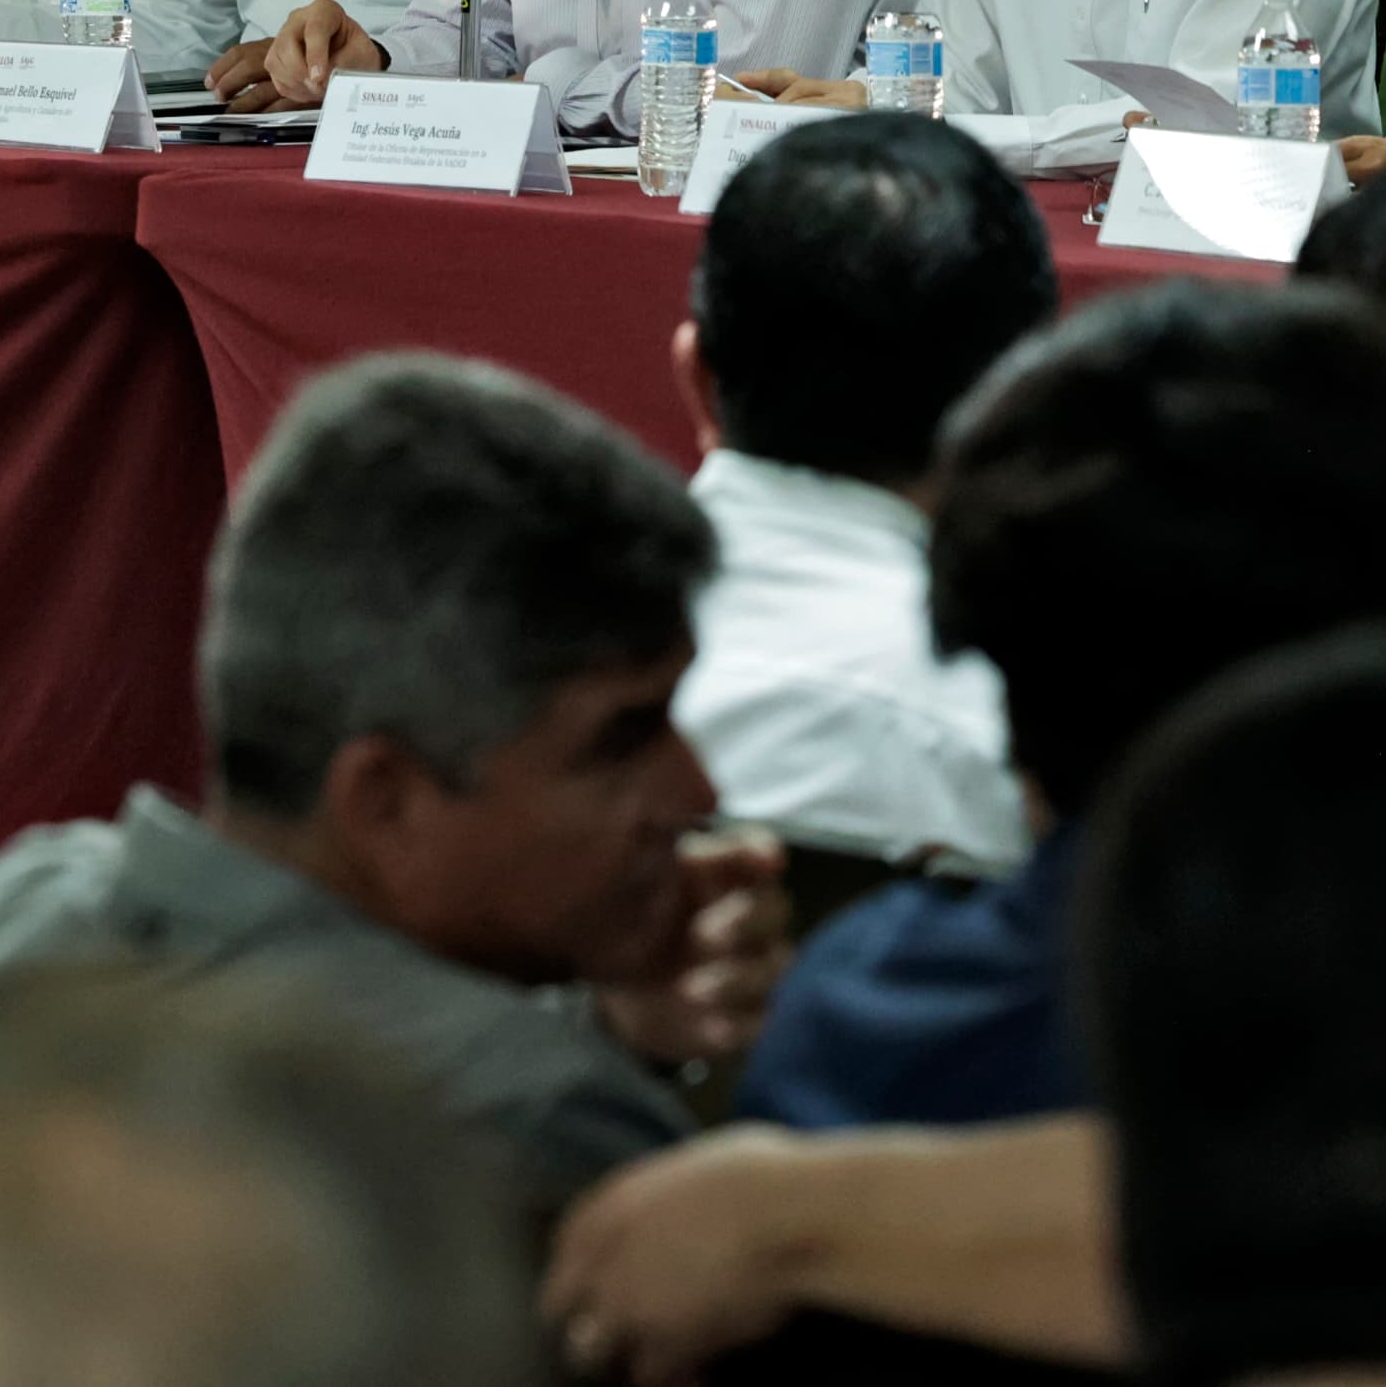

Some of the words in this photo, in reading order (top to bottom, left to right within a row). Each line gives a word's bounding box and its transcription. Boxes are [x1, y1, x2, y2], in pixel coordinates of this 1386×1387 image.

[17, 84, 38, 98] Bello
[39, 87, 77, 102] Esquivel
[361, 91, 399, 103] SINALOA
[373, 121, 400, 136] Jesús
[402, 123, 426, 140] Vega
[427, 125, 462, 140] Acuña
[739, 117, 777, 131] SINALOA
